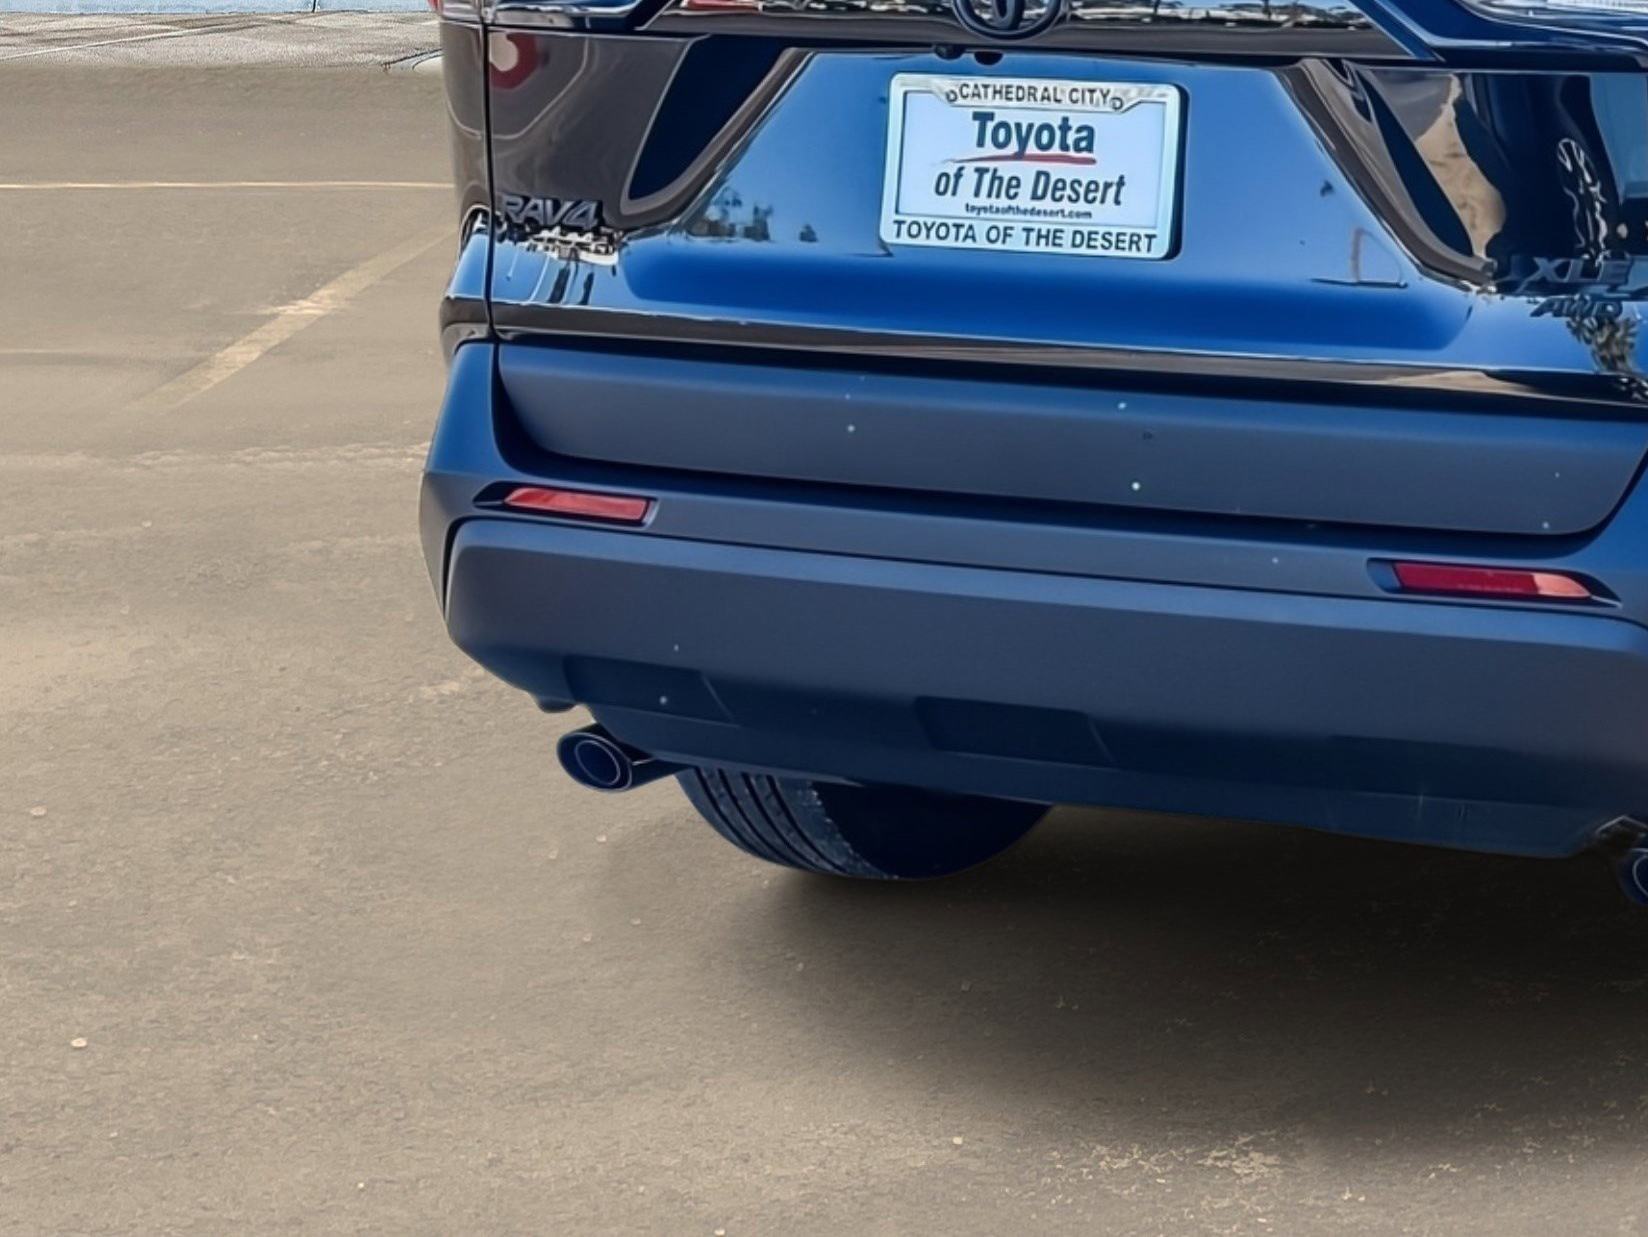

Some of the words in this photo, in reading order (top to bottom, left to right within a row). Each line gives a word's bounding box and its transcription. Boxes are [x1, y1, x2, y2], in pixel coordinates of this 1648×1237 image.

[959, 83, 1062, 105] CATHEDRAL
[1068, 88, 1111, 107] CITY
[972, 111, 1096, 159] Toyota
[934, 166, 965, 198] of
[973, 167, 1022, 200] The
[1031, 170, 1126, 206] Desert
[502, 195, 599, 229] RAV4
[965, 201, 1093, 220] toyotaofthedesert.com
[893, 219, 977, 244] TOYOTA
[986, 224, 1016, 246] OF
[1022, 226, 1064, 249] THE
[1071, 230, 1157, 255] DESERT
